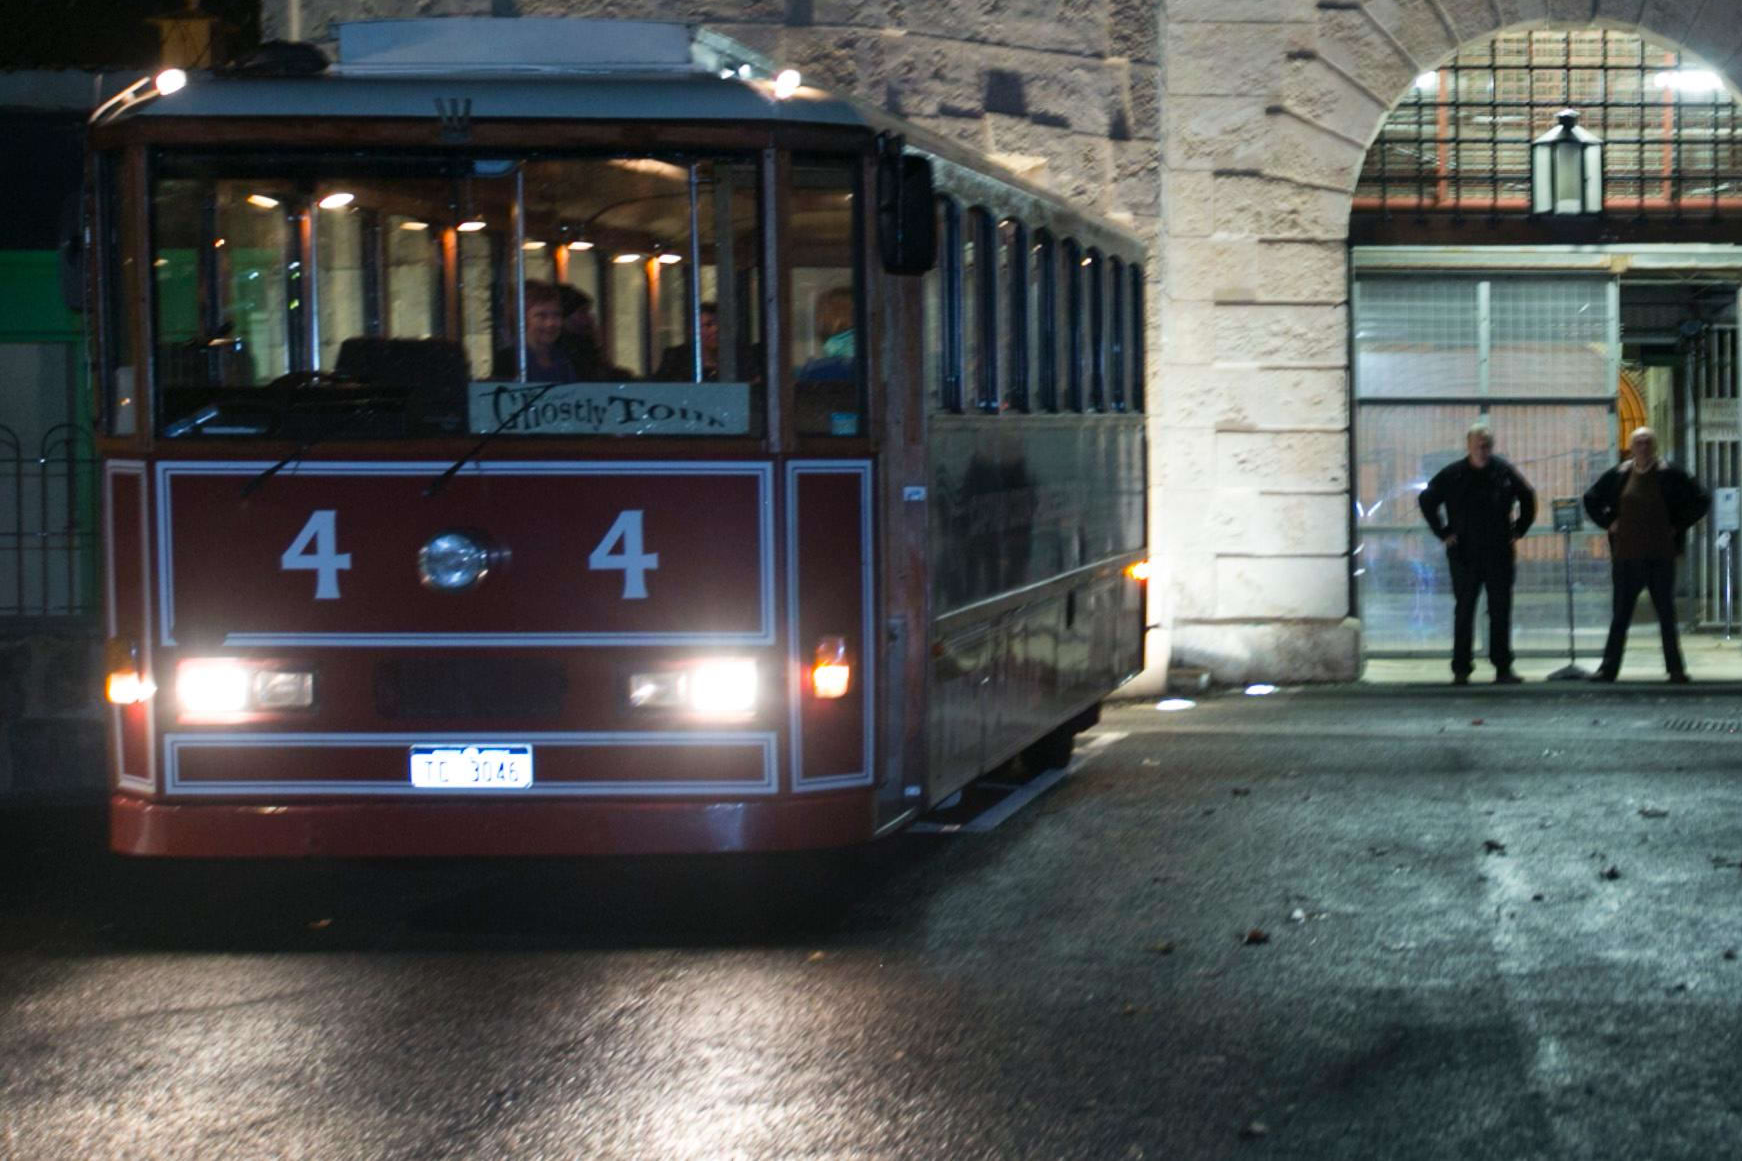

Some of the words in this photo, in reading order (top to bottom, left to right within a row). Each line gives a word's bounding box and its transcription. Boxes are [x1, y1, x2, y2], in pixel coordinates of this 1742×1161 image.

[493, 386, 607, 431] Ghostly
[281, 509, 352, 600] 4
[588, 509, 660, 600] 4
